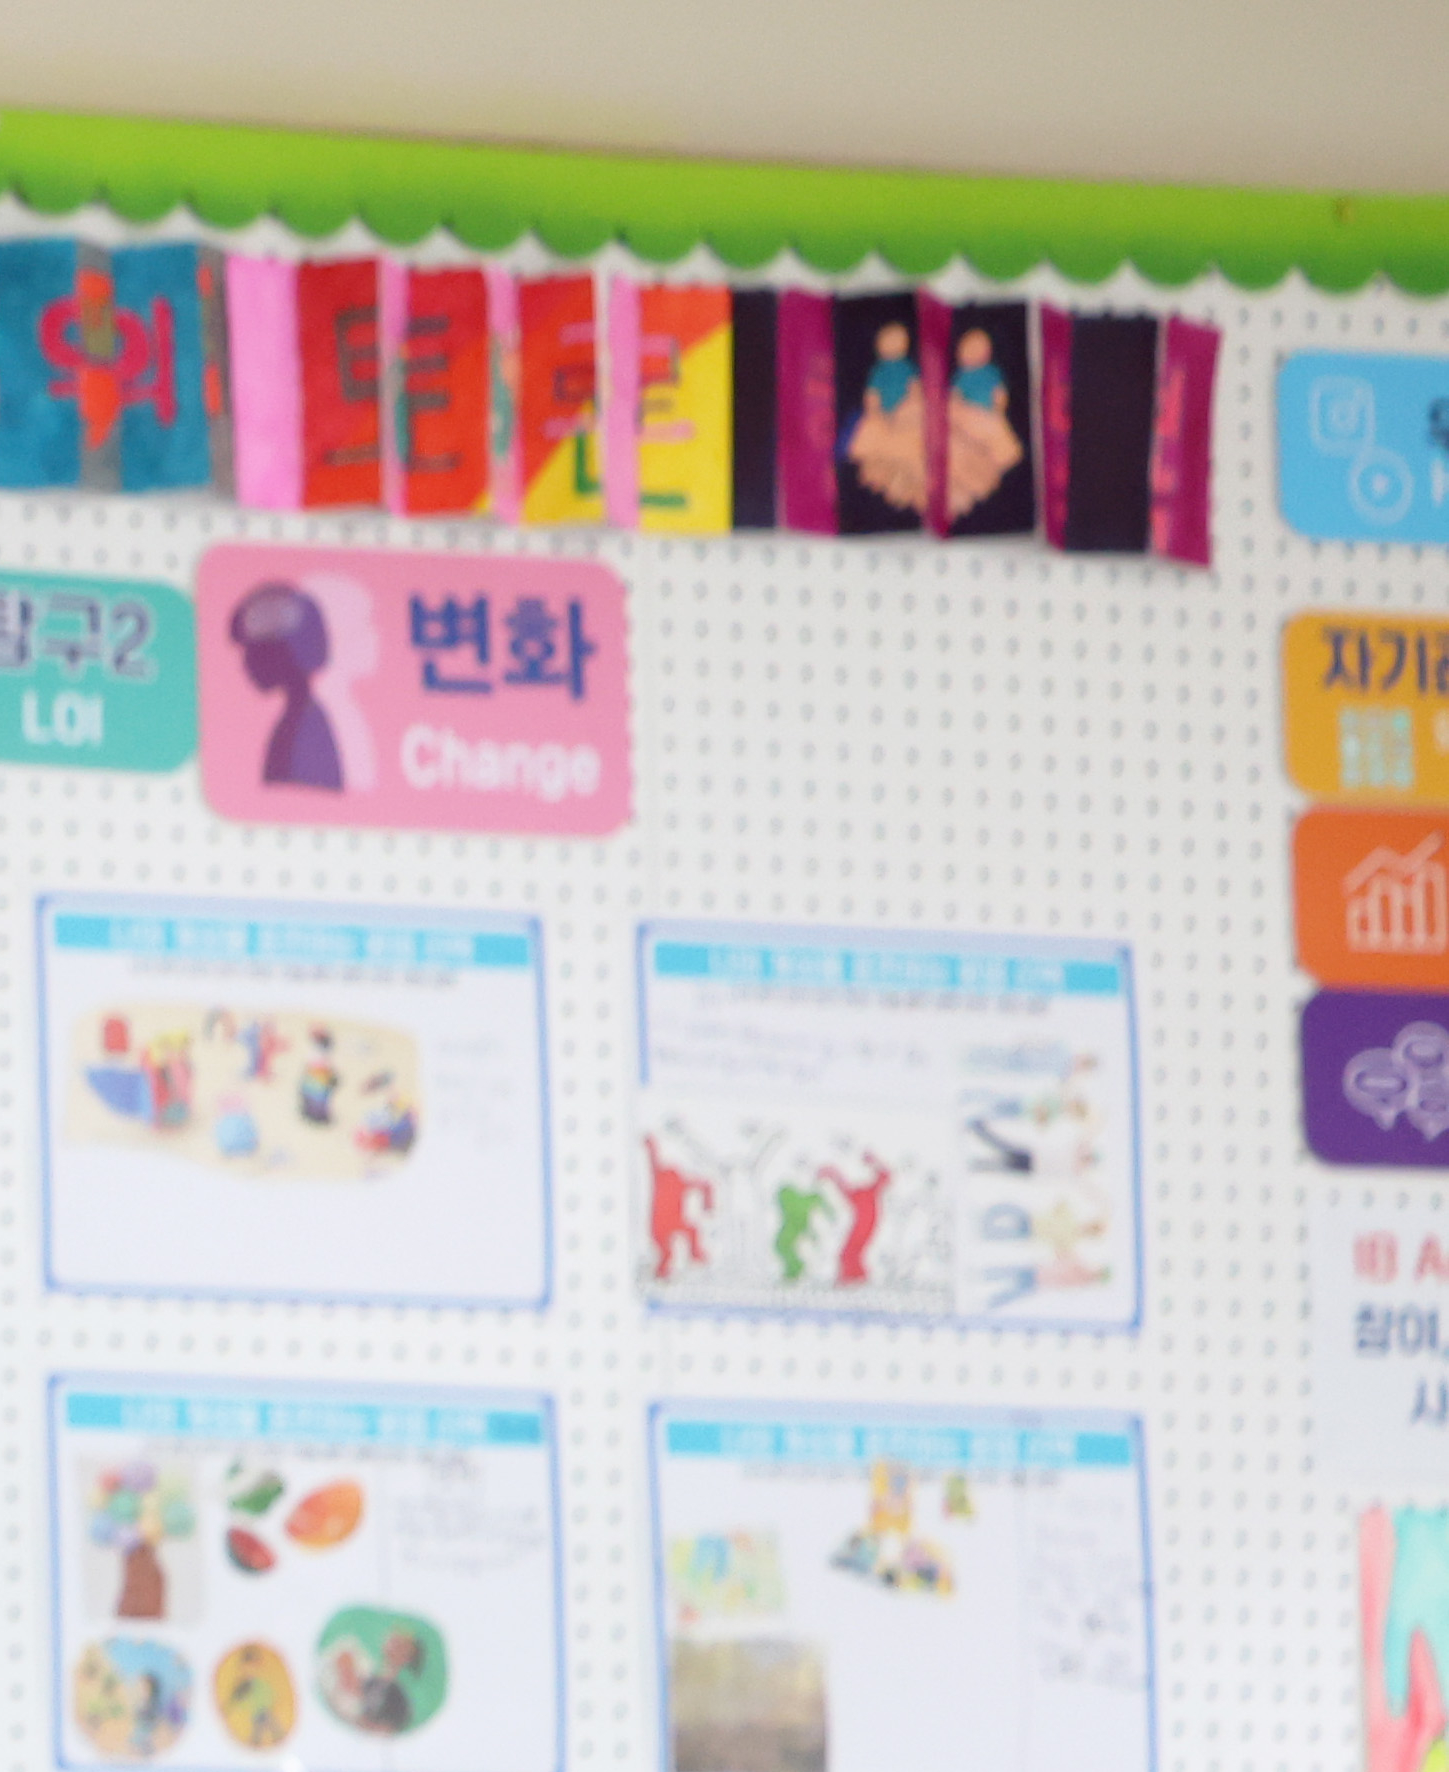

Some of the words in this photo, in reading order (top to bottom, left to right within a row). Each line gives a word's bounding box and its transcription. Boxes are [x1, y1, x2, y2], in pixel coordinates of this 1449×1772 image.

[405, 591, 597, 702] 변화
[21, 689, 104, 747] LOI
[400, 724, 601, 796] Change
